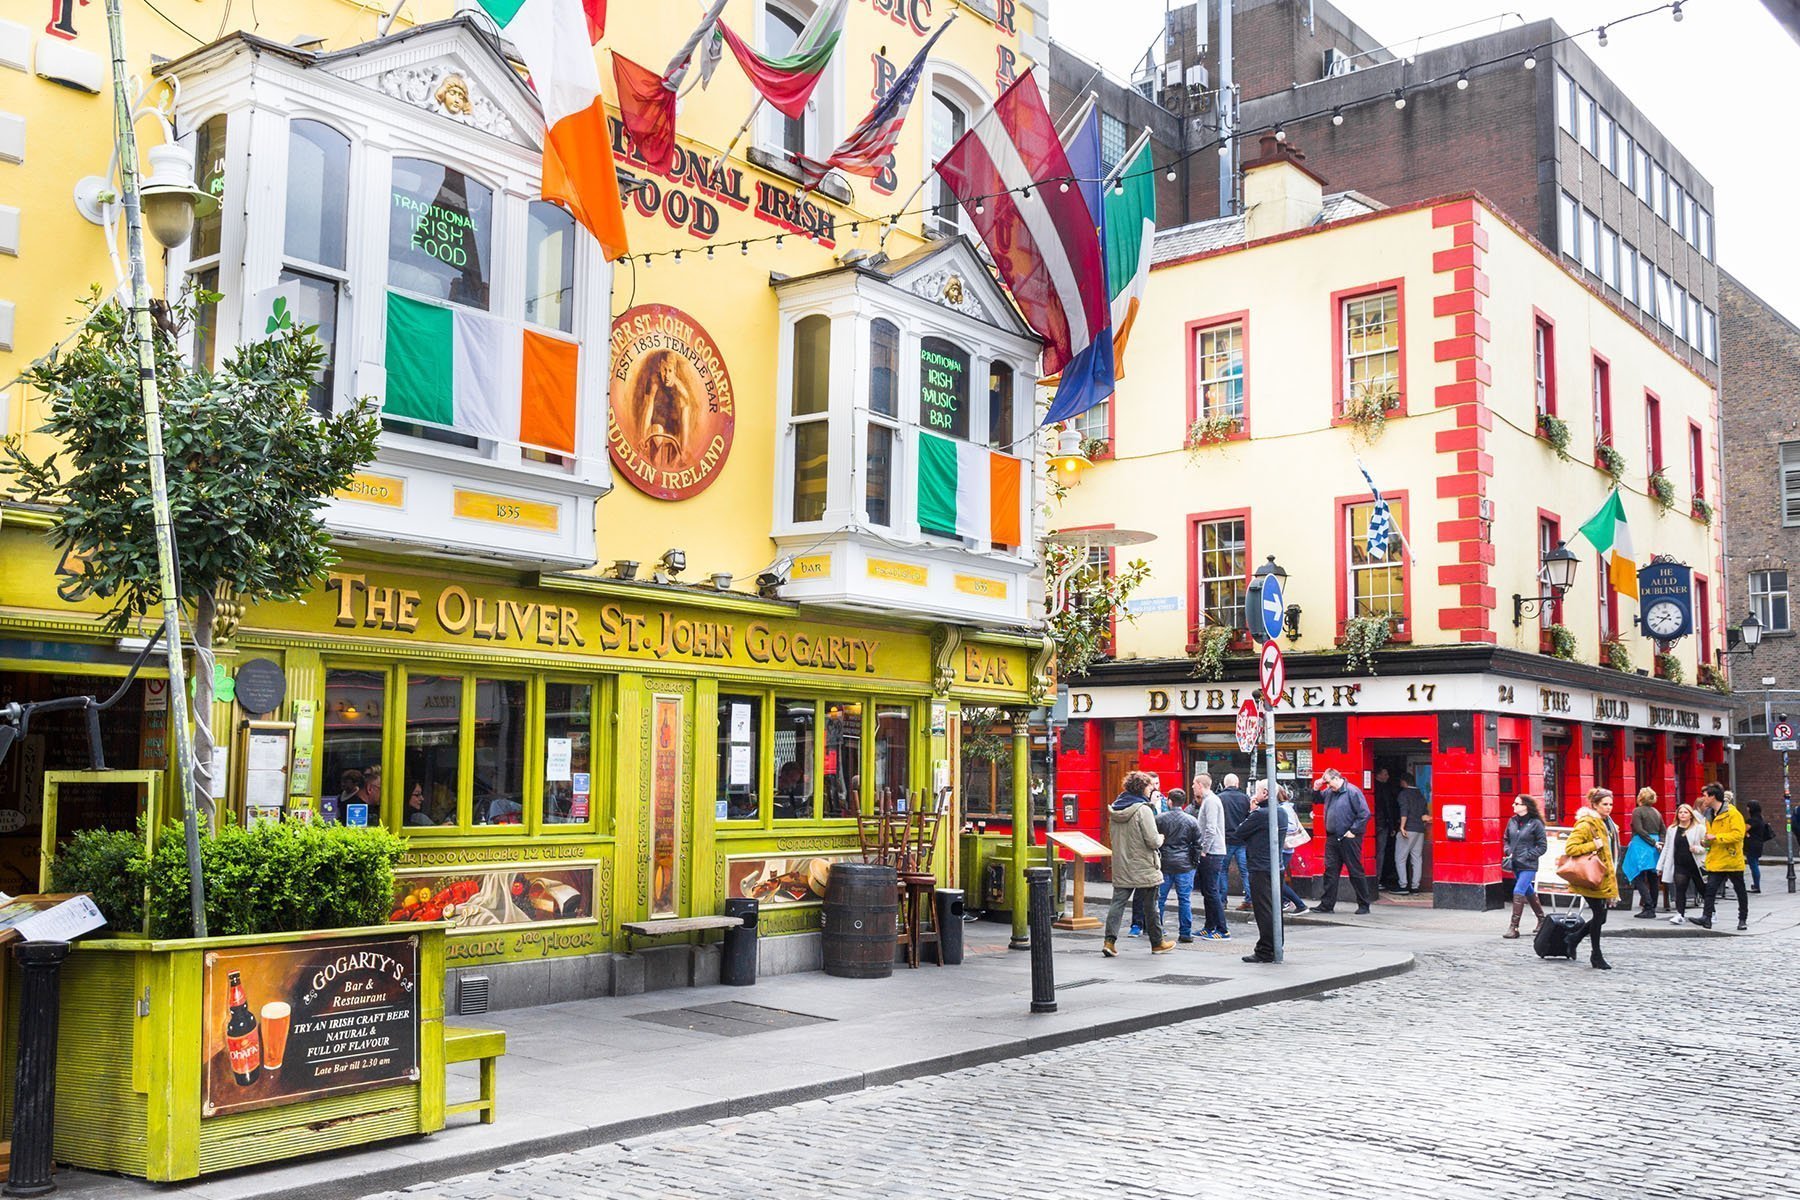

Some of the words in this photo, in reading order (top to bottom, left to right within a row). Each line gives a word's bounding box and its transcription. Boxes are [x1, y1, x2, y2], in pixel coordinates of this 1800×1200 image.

[393, 193, 478, 231] TRADITIONAL
[755, 181, 836, 249] IRISH
[411, 213, 463, 246] IRISH
[411, 234, 467, 266] FOOD
[616, 349, 635, 382] EST
[633, 334, 661, 355] 1835
[663, 335, 709, 379] TEMPLE
[704, 380, 718, 414] BAR
[635, 313, 652, 335] ST
[655, 313, 694, 344] JOHN
[693, 336, 733, 417] GOGARTY
[928, 369, 953, 390] IRISH
[922, 387, 957, 412] MUSIC
[930, 409, 952, 429] BAR
[608, 406, 657, 485] DUBLIN
[661, 434, 725, 490] IRELAND
[496, 503, 520, 519] 1835
[1641, 586, 1688, 596] DUBLINER
[1651, 577, 1678, 586] AULD
[325, 571, 421, 634] THE
[436, 584, 586, 648] OLIVER
[653, 611, 735, 659] JOHN
[745, 620, 882, 673] GOGARTY
[964, 645, 1014, 687] BAR
[1406, 683, 1436, 702] 17
[1498, 684, 1514, 704] 24
[1540, 686, 1572, 715] THE
[1594, 694, 1630, 722] AULD
[1649, 704, 1700, 729] DUBLINER
[523, 846, 538, 861] 12
[558, 844, 585, 858] late
[312, 951, 405, 990] GOGARTY'S
[344, 981, 364, 992] Bar
[365, 978, 374, 990] &
[333, 992, 387, 1008] Restaurant
[294, 1022, 312, 1034] TRY
[313, 1021, 327, 1032] AN
[328, 1017, 355, 1030] IRISH
[356, 1013, 386, 1026] CRAFT
[386, 1010, 410, 1021] BEER
[326, 1028, 368, 1042] NATURAL
[369, 1026, 376, 1035] &
[307, 1046, 331, 1058] FULL
[333, 1043, 347, 1053] OF
[348, 1036, 390, 1051] FLAVOUR
[314, 1066, 332, 1077] Late
[334, 1063, 348, 1073] Bar
[350, 1061, 360, 1070] till
[362, 1058, 378, 1069] 2.30
[379, 1057, 391, 1065] am
